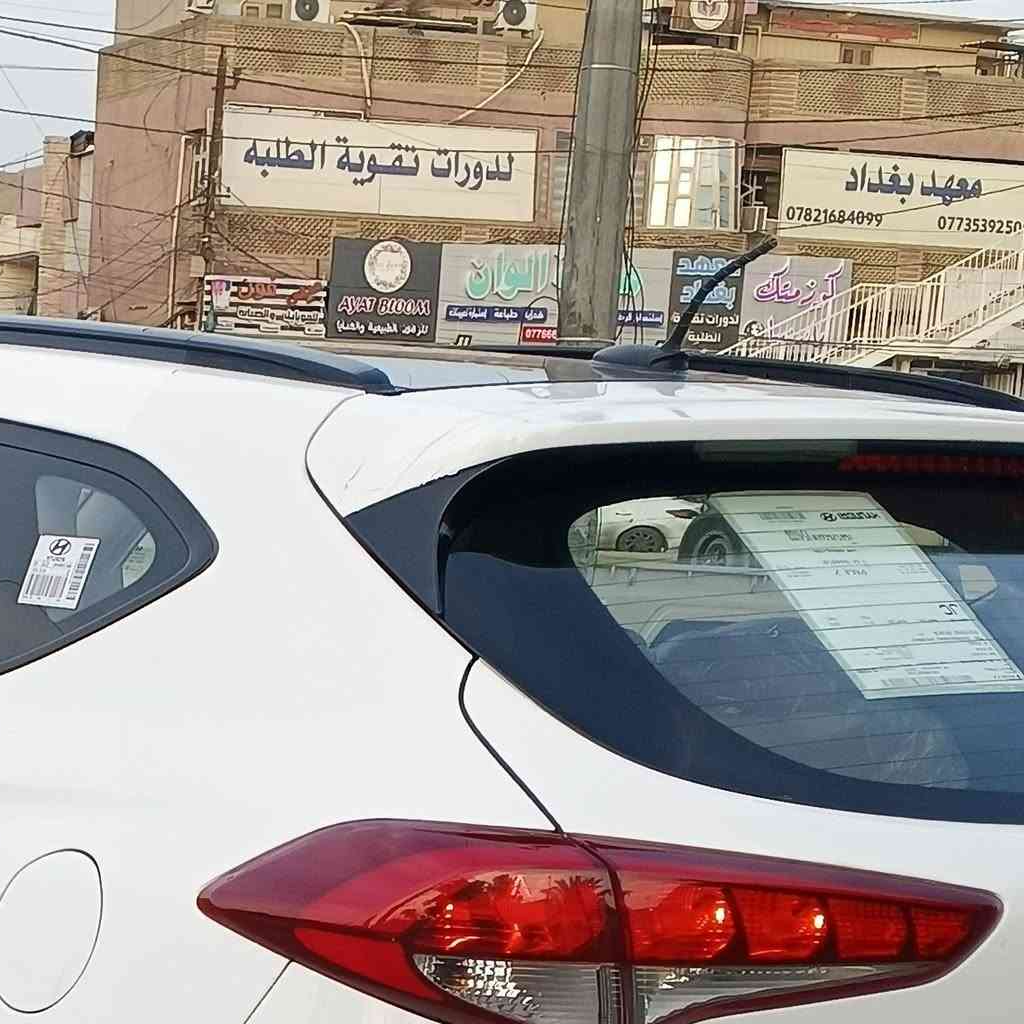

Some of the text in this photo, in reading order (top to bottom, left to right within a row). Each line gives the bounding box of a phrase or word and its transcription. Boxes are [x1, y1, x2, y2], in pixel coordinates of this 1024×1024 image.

[336, 136, 420, 186] تقوية
[431, 148, 515, 191] لدورات
[845, 162, 983, 206] معهد بغداد
[786, 206, 883, 228] 07821684099
[937, 216, 1024, 235] 0773539250
[338, 296, 376, 315] AYAT
[377, 297, 431, 316] BLOOM
[706, 313, 739, 328] لدورات
[688, 329, 721, 345] الطلبة
